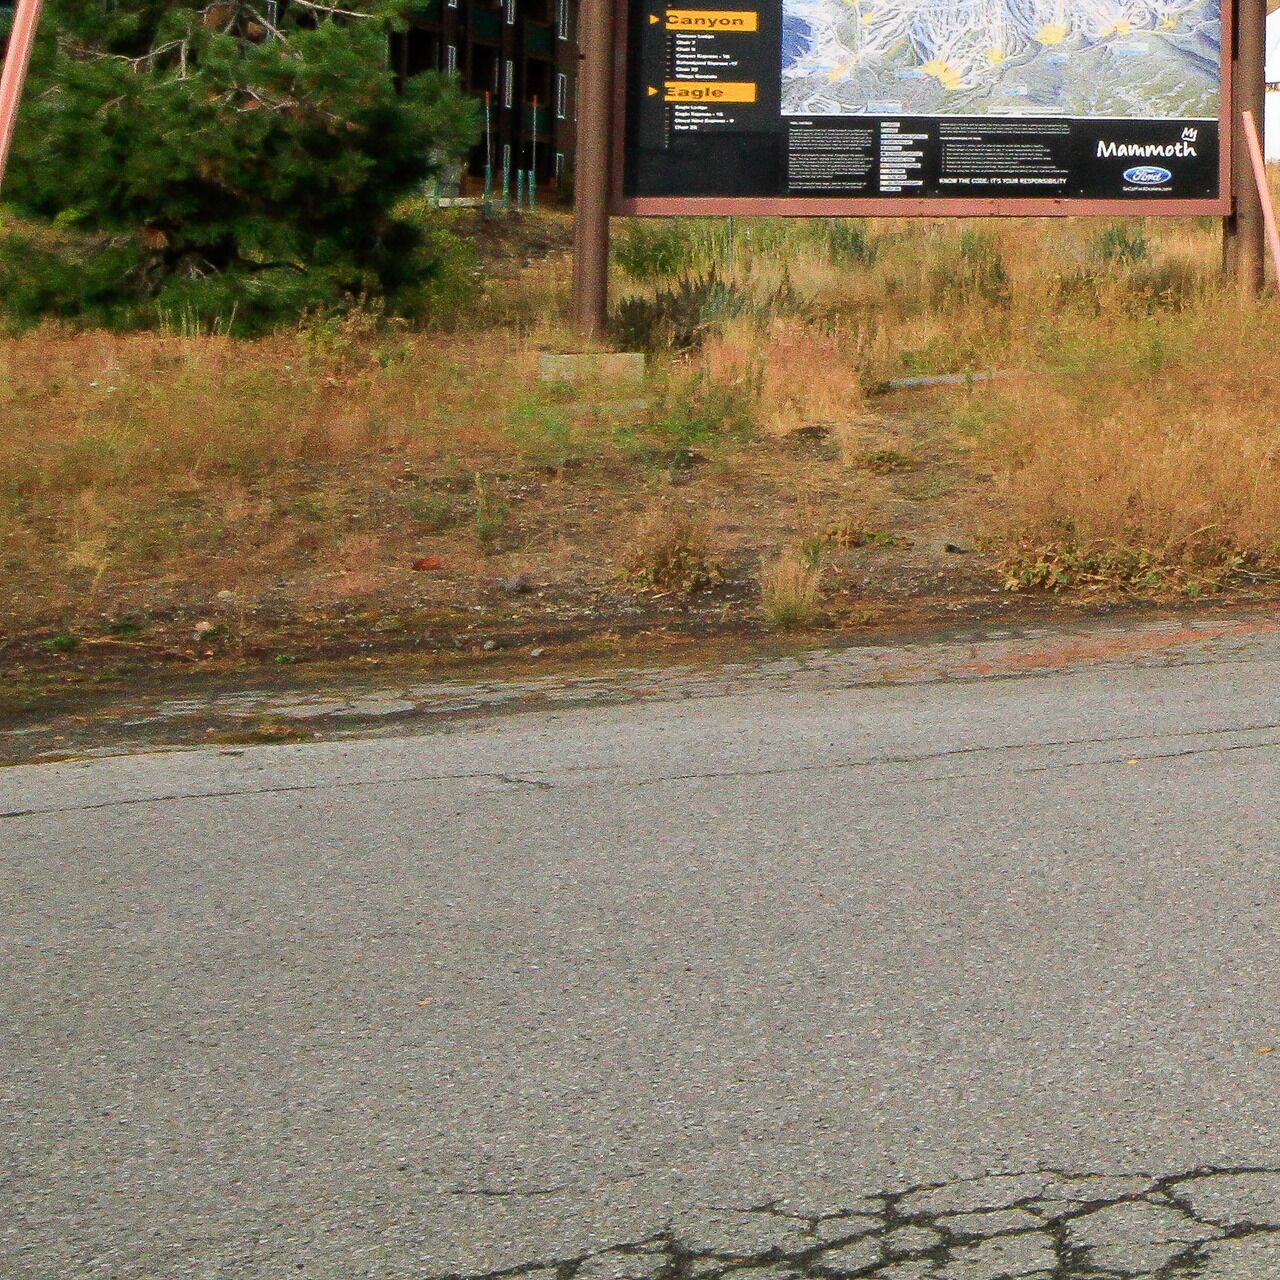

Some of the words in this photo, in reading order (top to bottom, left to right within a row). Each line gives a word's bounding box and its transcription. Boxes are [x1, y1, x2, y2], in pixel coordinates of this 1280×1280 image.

[667, 15, 744, 27] Canyon
[666, 87, 724, 99] Eagle
[1096, 140, 1197, 158] Mammoth
[1132, 168, 1162, 182] Ford
